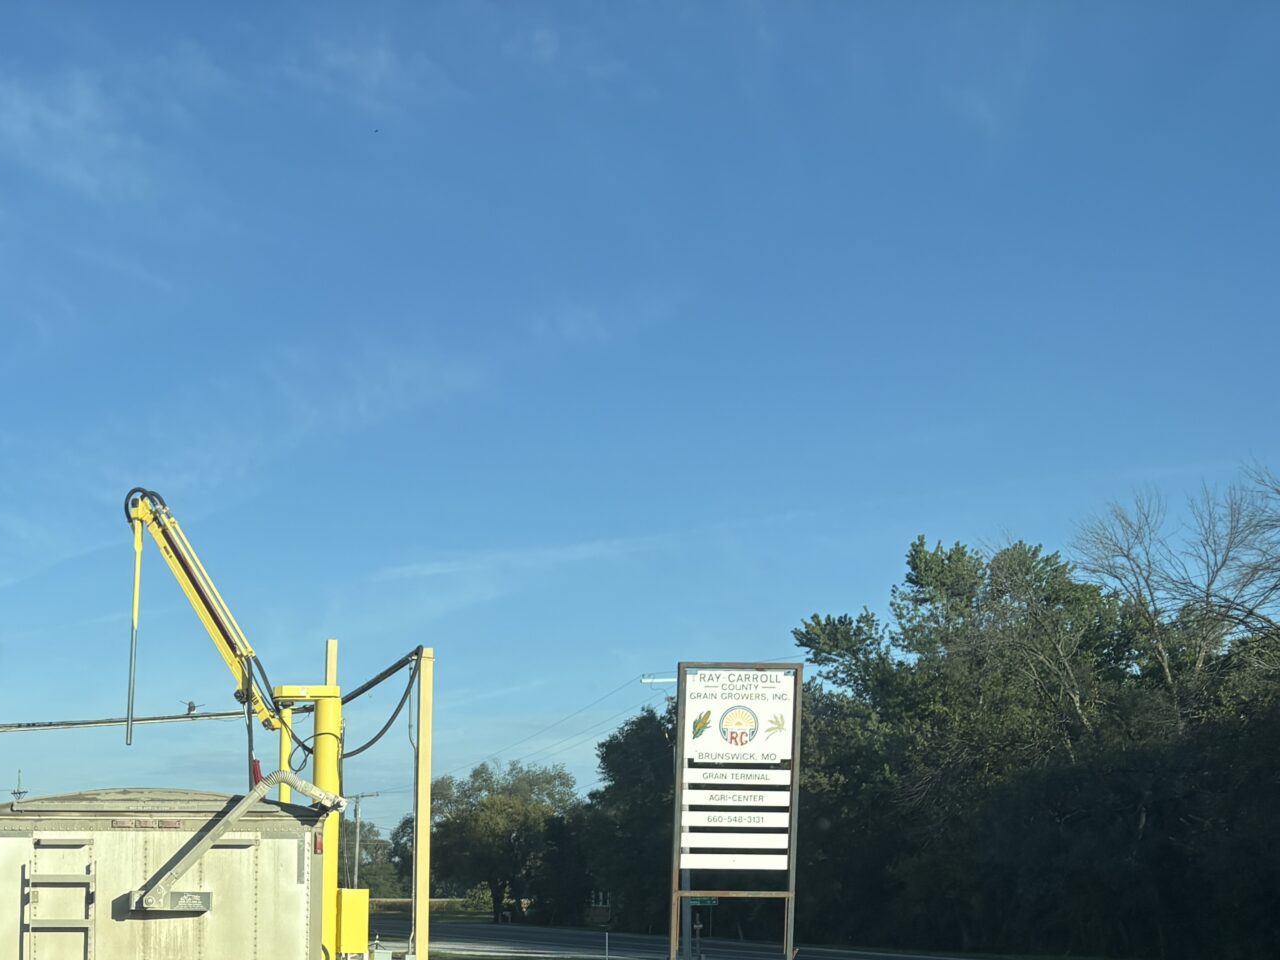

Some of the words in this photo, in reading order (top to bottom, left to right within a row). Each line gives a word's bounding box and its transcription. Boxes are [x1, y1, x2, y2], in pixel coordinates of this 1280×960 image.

[721, 683, 759, 691] COUNTY
[689, 691, 718, 700] GRAIN
[720, 692, 769, 701] GROWERS,
[728, 730, 750, 747] RC
[761, 753, 777, 761] MO
[702, 772, 728, 780] GRAIN
[731, 772, 771, 781] TERMINAL
[708, 794, 765, 802] AGRI-CENTER
[706, 815, 765, 824] 660-548-3131
